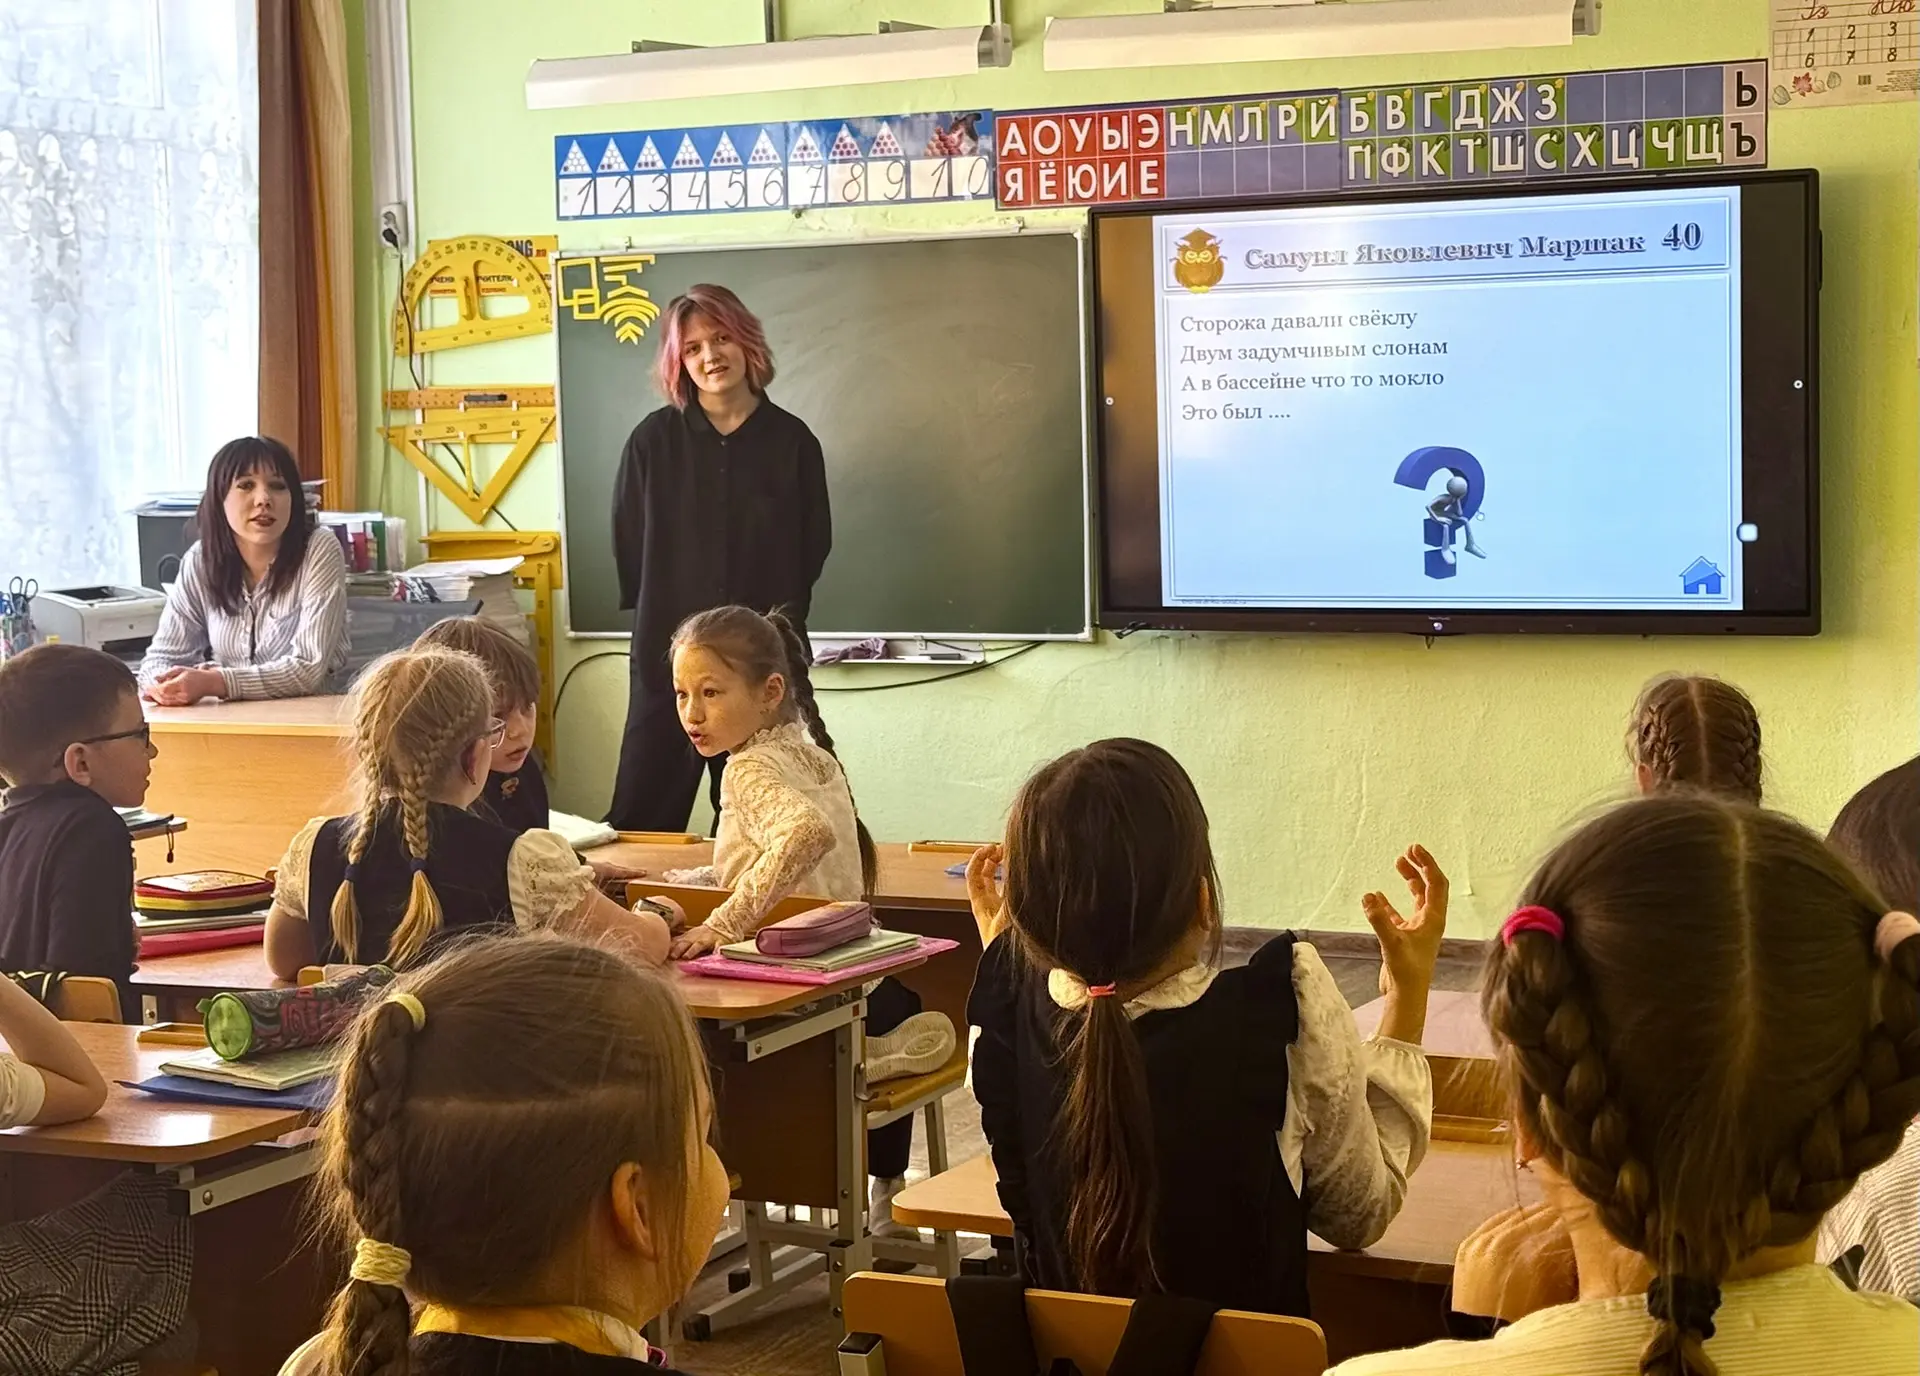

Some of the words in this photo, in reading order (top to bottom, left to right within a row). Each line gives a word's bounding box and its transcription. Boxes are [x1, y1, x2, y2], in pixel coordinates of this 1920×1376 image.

[1847, 25, 1856, 39] 2
[1887, 21, 1897, 36] 3
[1805, 53, 1815, 68] 6
[1887, 48, 1897, 62] 8
[577, 178, 594, 217] 1
[612, 175, 632, 214] 2
[648, 173, 669, 212] 3
[688, 173, 706, 209] 4
[724, 169, 745, 208] 5
[763, 167, 784, 206] 6
[806, 164, 823, 205] 7
[842, 162, 864, 202] 8
[883, 160, 905, 200] 9
[1243, 247, 1348, 272] Самуил
[1353, 241, 1513, 265] Яковлевич
[1519, 234, 1646, 261] Маршак
[1661, 222, 1703, 250] 40
[1180, 315, 1266, 336] Сторожа
[1270, 314, 1343, 333] давали
[1348, 309, 1418, 330] свёклу
[1180, 345, 1233, 365] Двум
[1237, 344, 1367, 364] задумчивым
[1371, 341, 1449, 358] слонам
[1181, 376, 1197, 392] А
[1201, 379, 1212, 391] в
[1217, 372, 1306, 390] бассейне
[1311, 375, 1346, 389] что
[1351, 375, 1374, 388] то
[1378, 372, 1445, 387] мокло
[1182, 405, 1218, 421] Это
[1222, 403, 1263, 420] был
